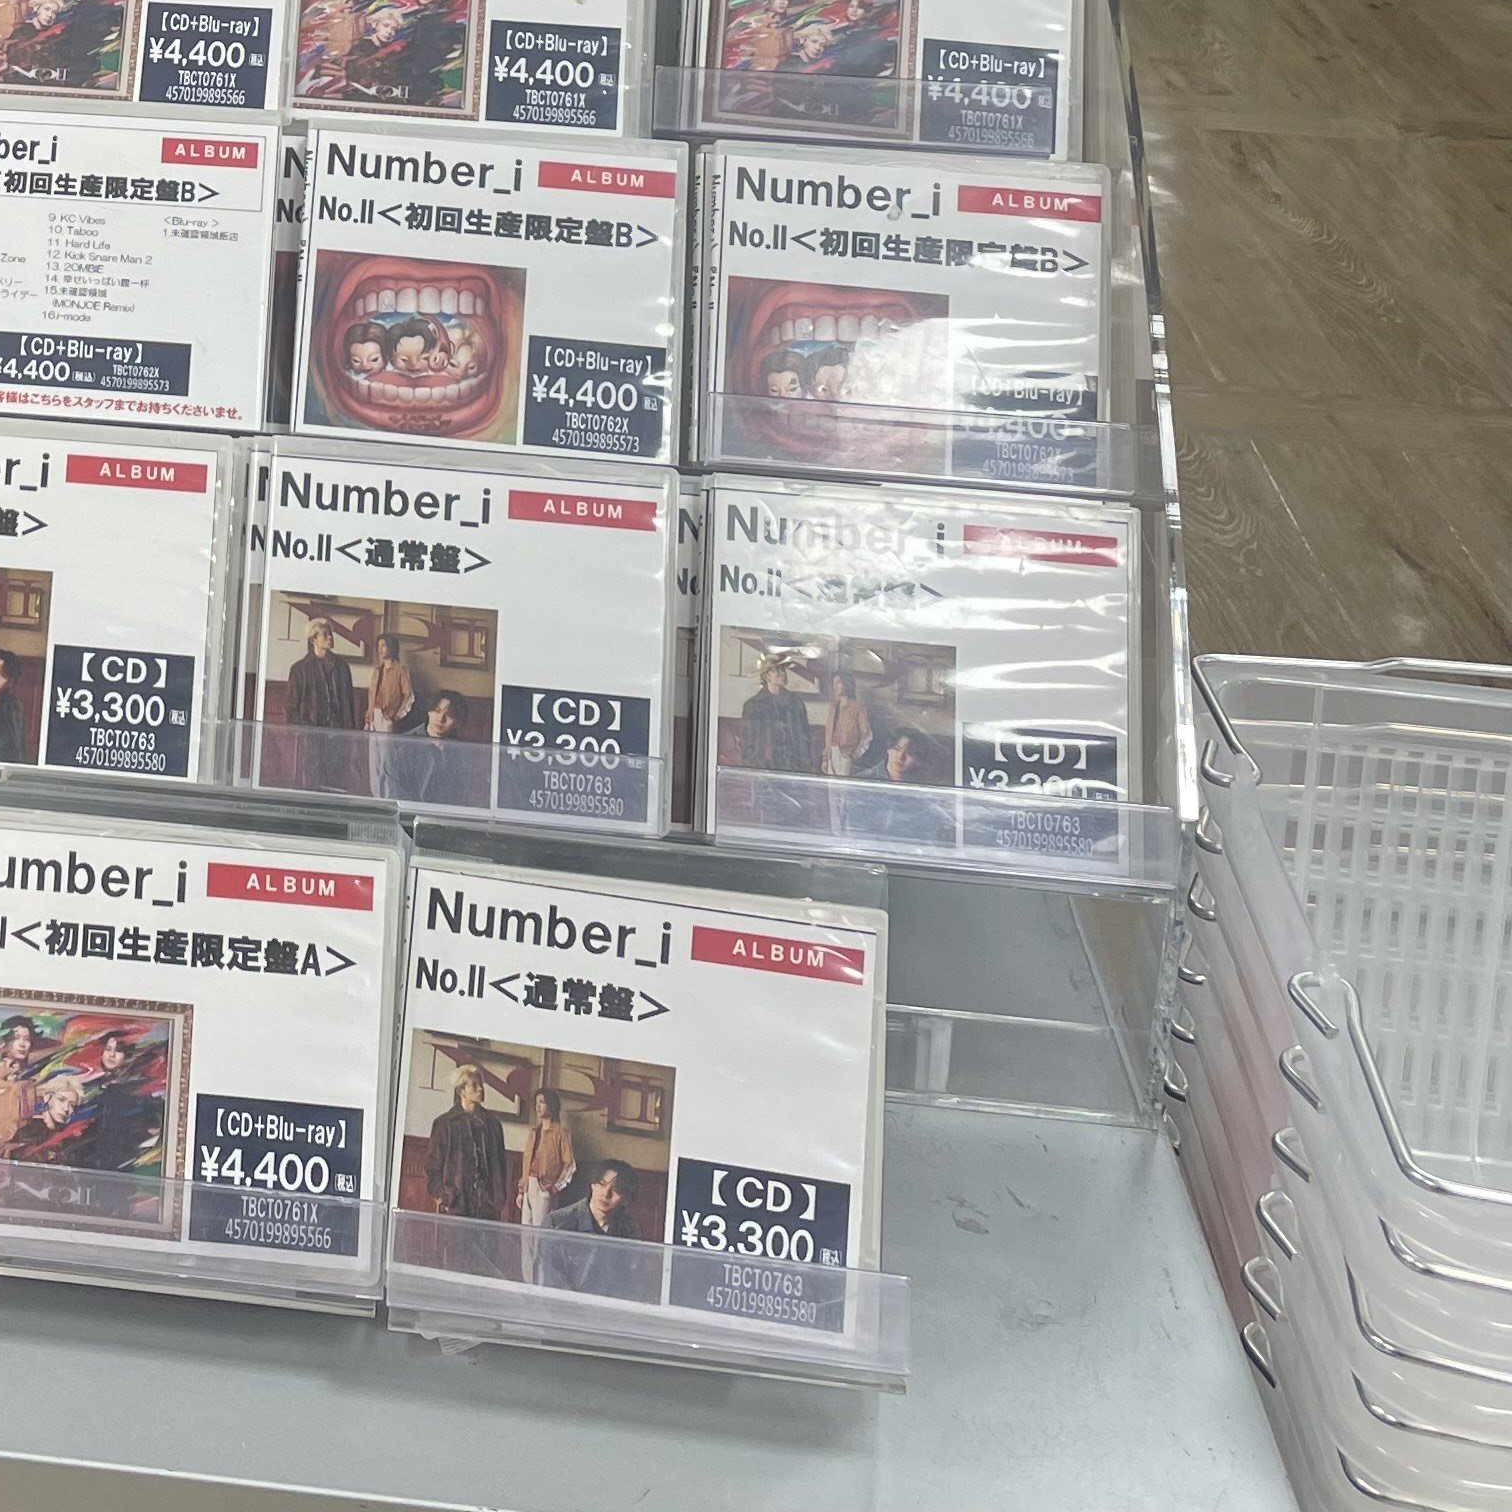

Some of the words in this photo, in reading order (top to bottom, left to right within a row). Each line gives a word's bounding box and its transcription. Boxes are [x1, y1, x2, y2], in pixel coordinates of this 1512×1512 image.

[178, 70, 236, 88] TBCT0761X
[165, 86, 245, 105] 4570199895566
[525, 89, 586, 107] TBCT0761X
[512, 105, 596, 126] 4570199895566
[960, 109, 1024, 130] TBCT0761X
[174, 144, 246, 160] ALBUM
[326, 143, 524, 194] Number_i
[570, 170, 645, 188] ALBUM
[736, 167, 941, 218] Number_i
[991, 196, 1070, 212] ALBUM
[99, 377, 170, 391] 4570199895573
[112, 364, 160, 379] TBCT0762X
[565, 411, 630, 434] TBCT0762X
[552, 431, 640, 453] 4570199895573
[99, 462, 176, 482] ALBUM
[279, 470, 492, 528] Number_i
[543, 499, 624, 520] ALBUM
[89, 727, 156, 750] TBCT0763
[75, 747, 166, 772] 4570199895580
[543, 770, 612, 795] TBCT0763
[529, 791, 624, 816] 4570199895580
[1008, 809, 1081, 835] TBCT0763
[246, 871, 335, 898] ALBUM
[426, 887, 671, 968] Number_i
[732, 938, 825, 969] ALBUM
[241, 1195, 319, 1224] TBCT0761X
[225, 1217, 332, 1249] 4570199895566
[723, 1263, 803, 1297] TBCT0763
[706, 1285, 817, 1324] 4570199895580
